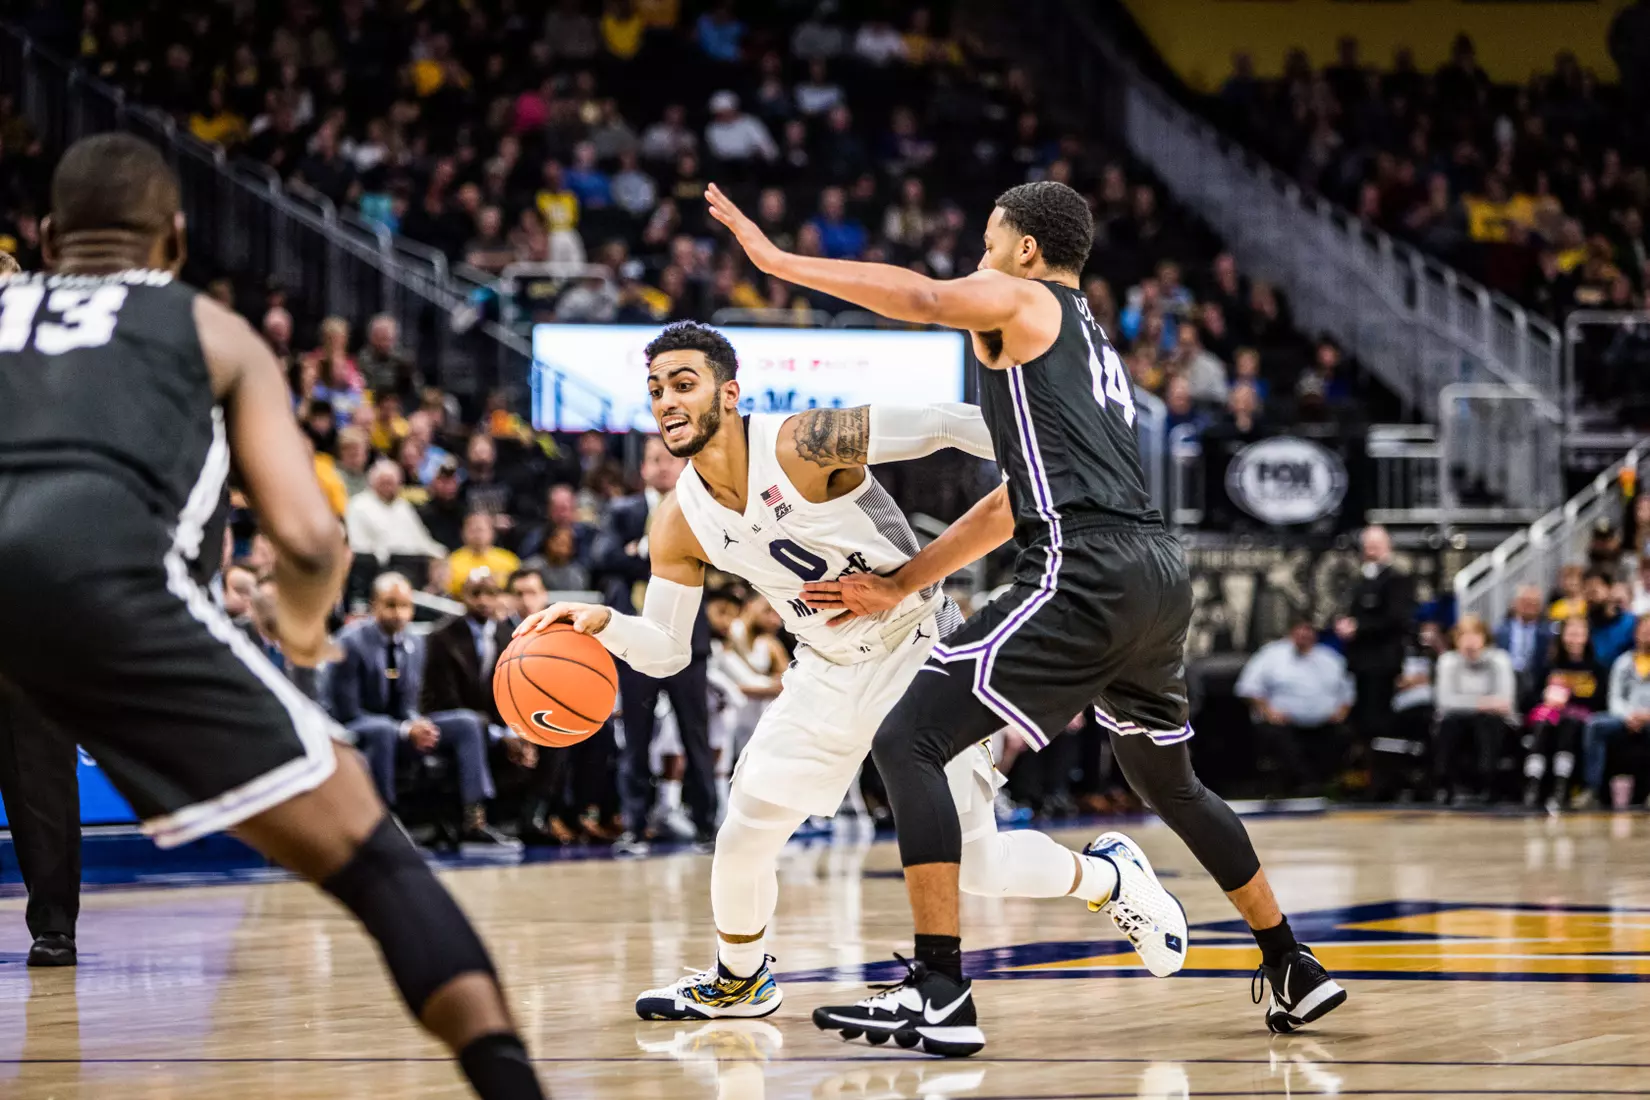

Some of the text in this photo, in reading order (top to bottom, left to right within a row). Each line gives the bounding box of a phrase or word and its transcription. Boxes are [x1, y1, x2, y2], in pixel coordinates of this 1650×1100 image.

[0, 284, 128, 355] 13
[1080, 320, 1136, 428] 14
[1257, 461, 1312, 488] FOX
[776, 504, 792, 518] EAST
[769, 538, 828, 581] 0
